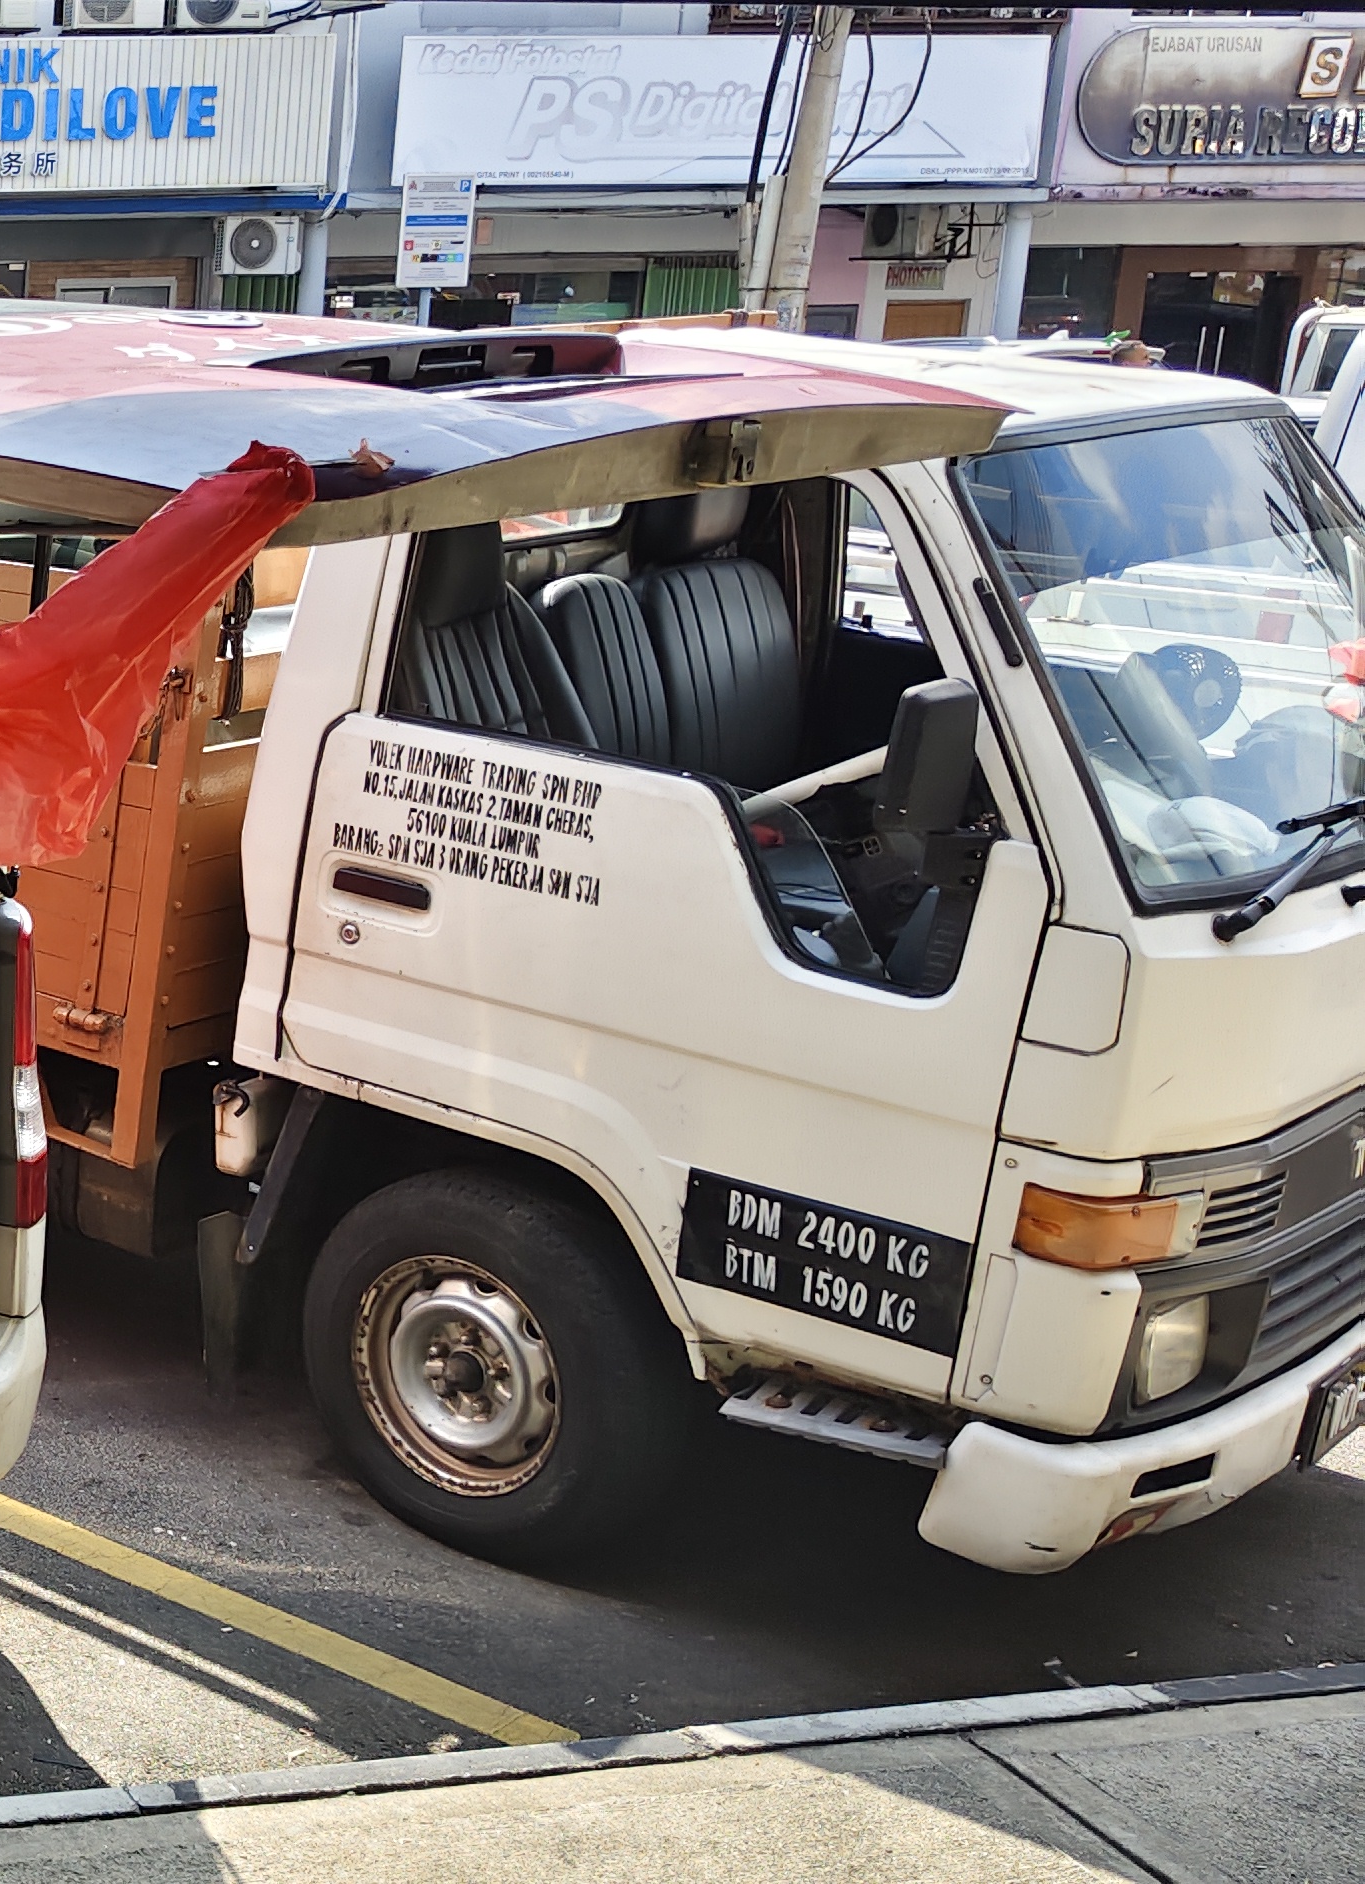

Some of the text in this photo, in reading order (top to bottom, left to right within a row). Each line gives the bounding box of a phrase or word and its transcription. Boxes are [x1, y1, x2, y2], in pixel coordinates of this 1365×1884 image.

[419, 43, 505, 76] Kedai
[1142, 36, 1262, 53] PEJABAT URUSAN
[1311, 47, 1343, 86] S
[506, 76, 631, 163] PS
[1130, 103, 1365, 156] SURIA RECO
[436, 784, 484, 816] KASKAS
[407, 807, 541, 859] 56100 KUALA LUMPUR
[438, 844, 446, 871] 3
[490, 855, 544, 894] PEKERJA
[727, 1189, 930, 1279] BDM 2400 KG
[725, 1240, 917, 1334] BTM 1590 KG
